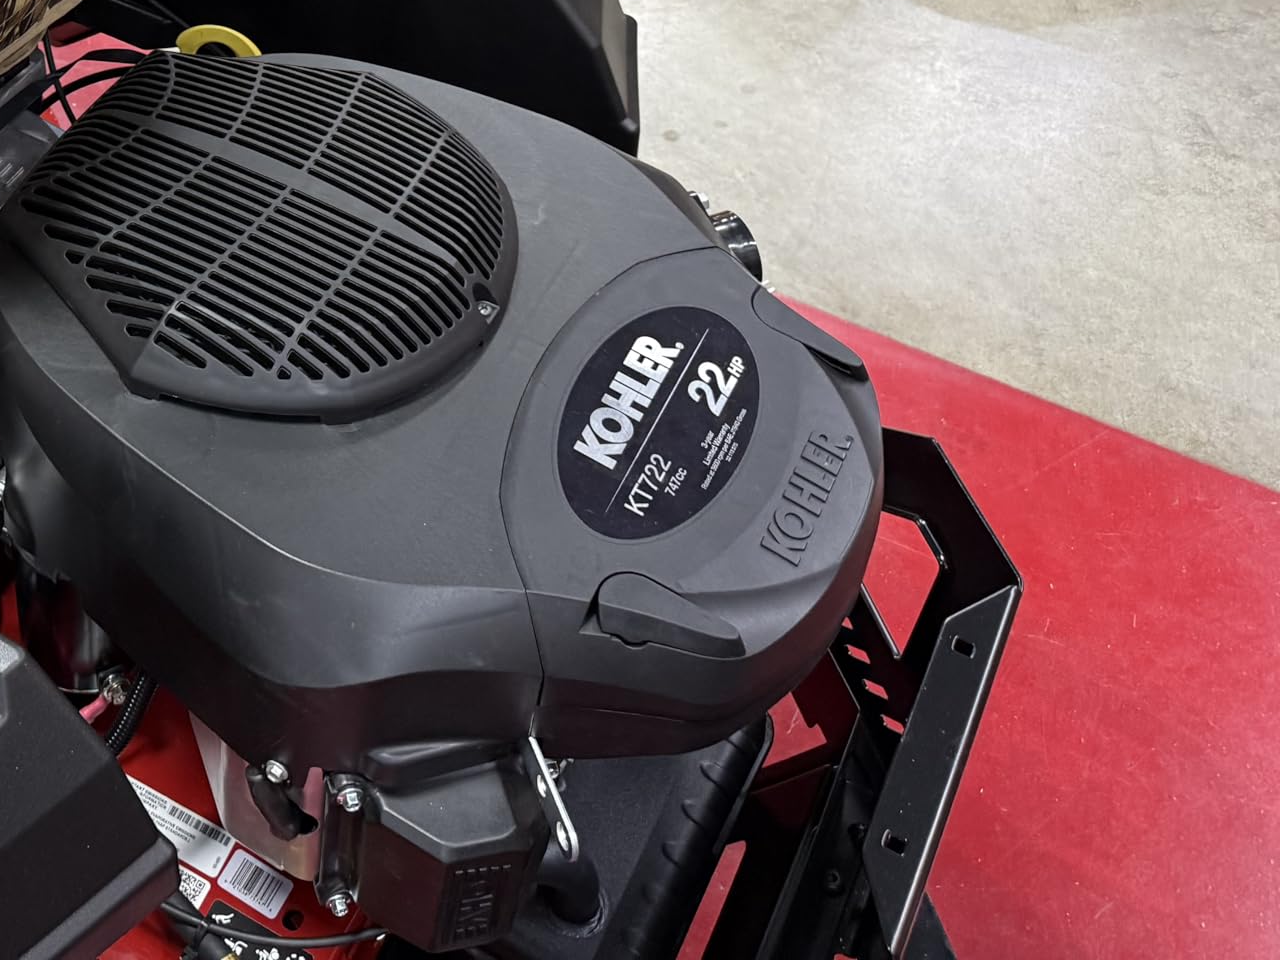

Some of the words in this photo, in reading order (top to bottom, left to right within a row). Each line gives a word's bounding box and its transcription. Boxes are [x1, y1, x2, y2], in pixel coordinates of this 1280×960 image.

[573, 336, 682, 470] KOHLER
[702, 445, 717, 465] Limited
[713, 423, 729, 446] Warranty
[624, 454, 672, 517] KT722
[664, 467, 688, 496] 747cc
[760, 431, 850, 567] KOHLER
